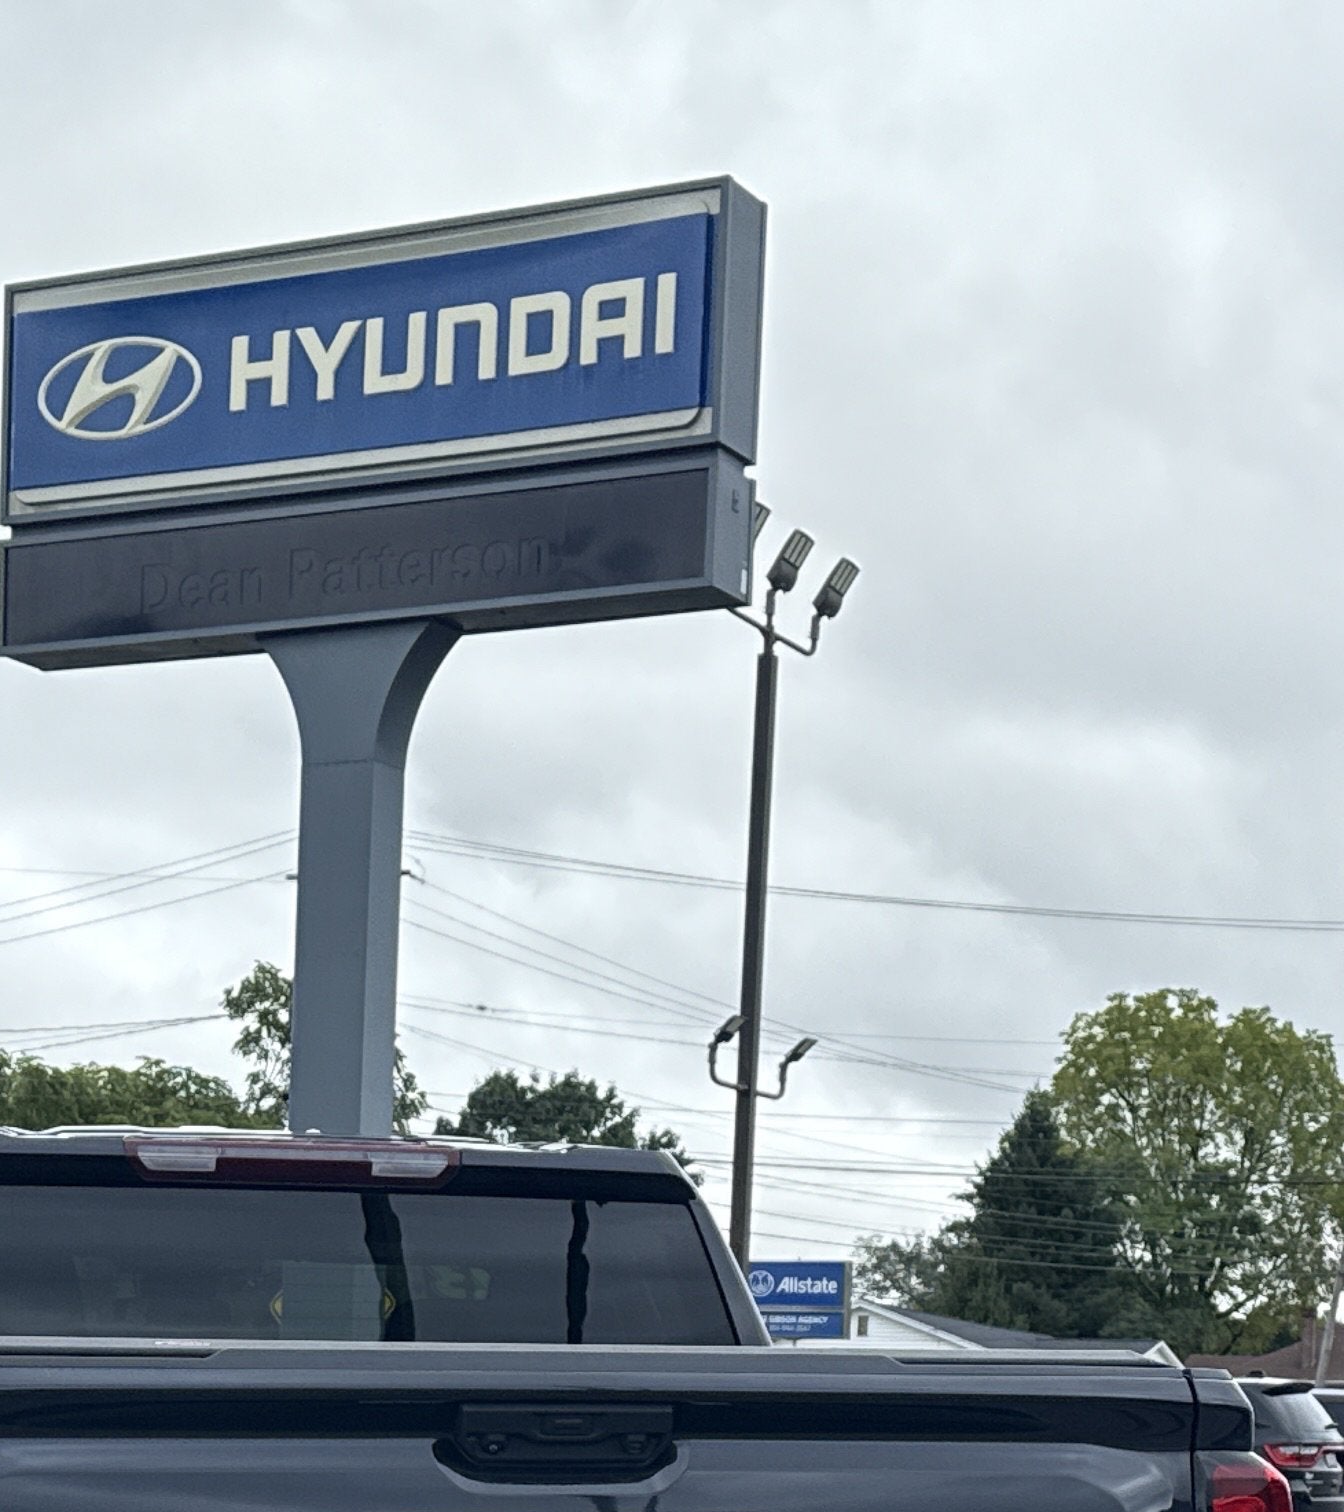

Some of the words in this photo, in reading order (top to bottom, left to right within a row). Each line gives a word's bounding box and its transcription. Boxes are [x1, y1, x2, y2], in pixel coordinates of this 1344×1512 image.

[228, 271, 678, 412] HYUNDAI
[139, 561, 264, 617] Dean
[288, 534, 552, 601] Patterson
[776, 1276, 838, 1294] Allstate
